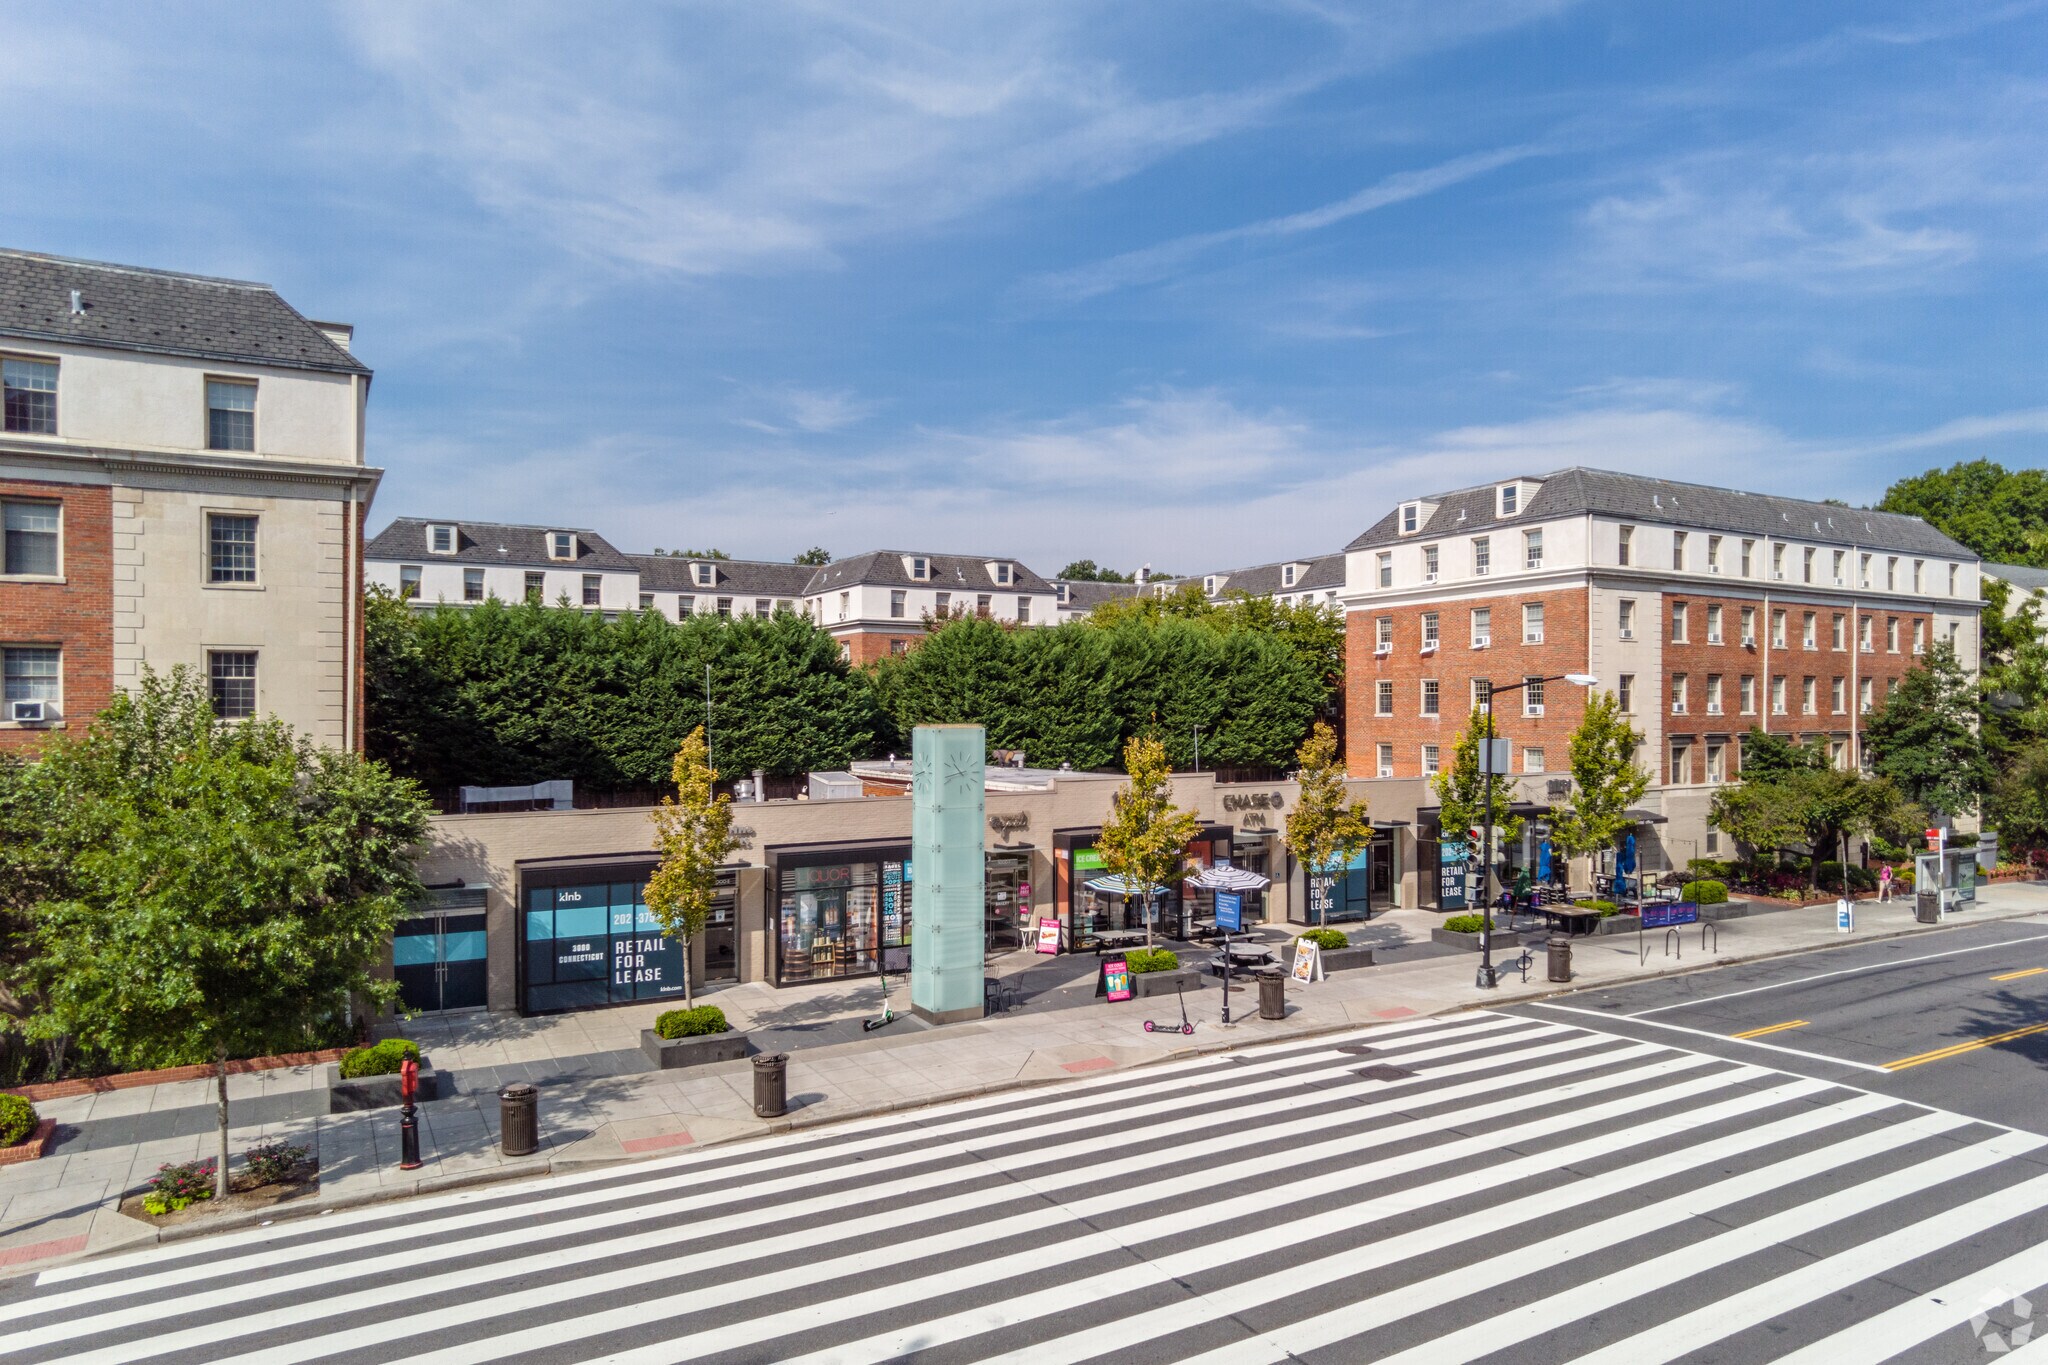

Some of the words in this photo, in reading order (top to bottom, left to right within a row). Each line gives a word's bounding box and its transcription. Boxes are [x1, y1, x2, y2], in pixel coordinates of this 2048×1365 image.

[1223, 793, 1271, 811] CHASE
[1076, 853, 1085, 863] ICE
[1086, 852, 1102, 862] CREA
[1441, 866, 1464, 877] RETAIL
[1311, 877, 1336, 888] REAIL
[1441, 877, 1455, 887] FOR
[559, 891, 582, 902] klnb
[1311, 888, 1322, 899] FO
[1441, 886, 1462, 897] LEASE
[615, 938, 666, 954] RETAIL
[558, 952, 605, 964] CONNECTICUT
[615, 954, 645, 969] FOR
[615, 967, 662, 985] LEASE
